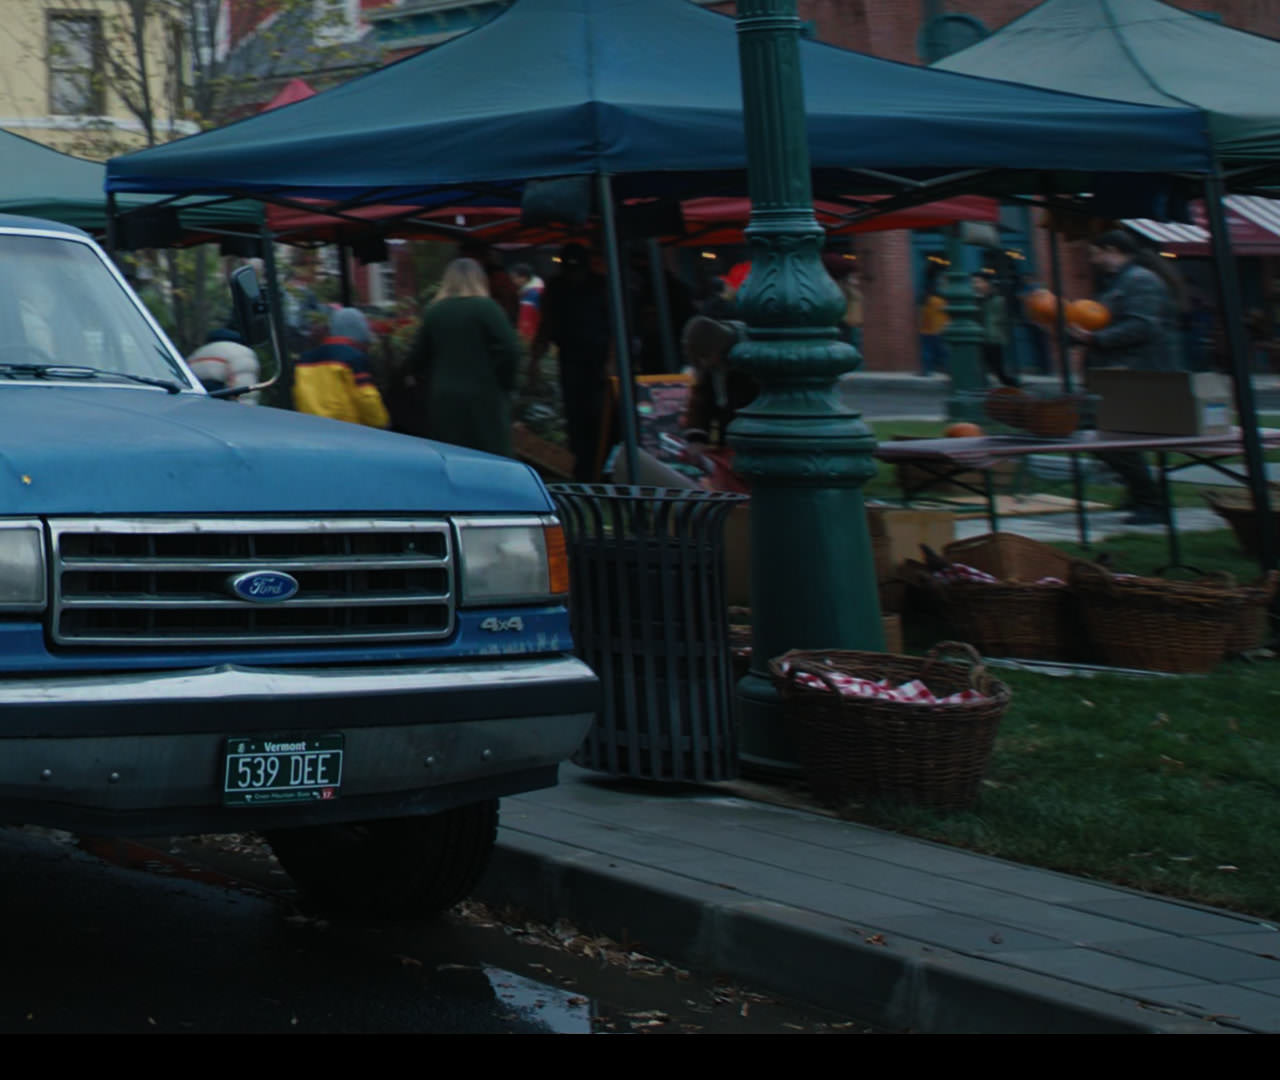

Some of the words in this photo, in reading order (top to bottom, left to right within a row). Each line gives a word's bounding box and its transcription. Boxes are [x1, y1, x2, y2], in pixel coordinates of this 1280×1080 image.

[248, 576, 283, 595] Ford
[480, 616, 524, 632] 4x4
[263, 740, 307, 753] Vermont
[237, 756, 280, 788] 539
[289, 753, 331, 786] DEE
